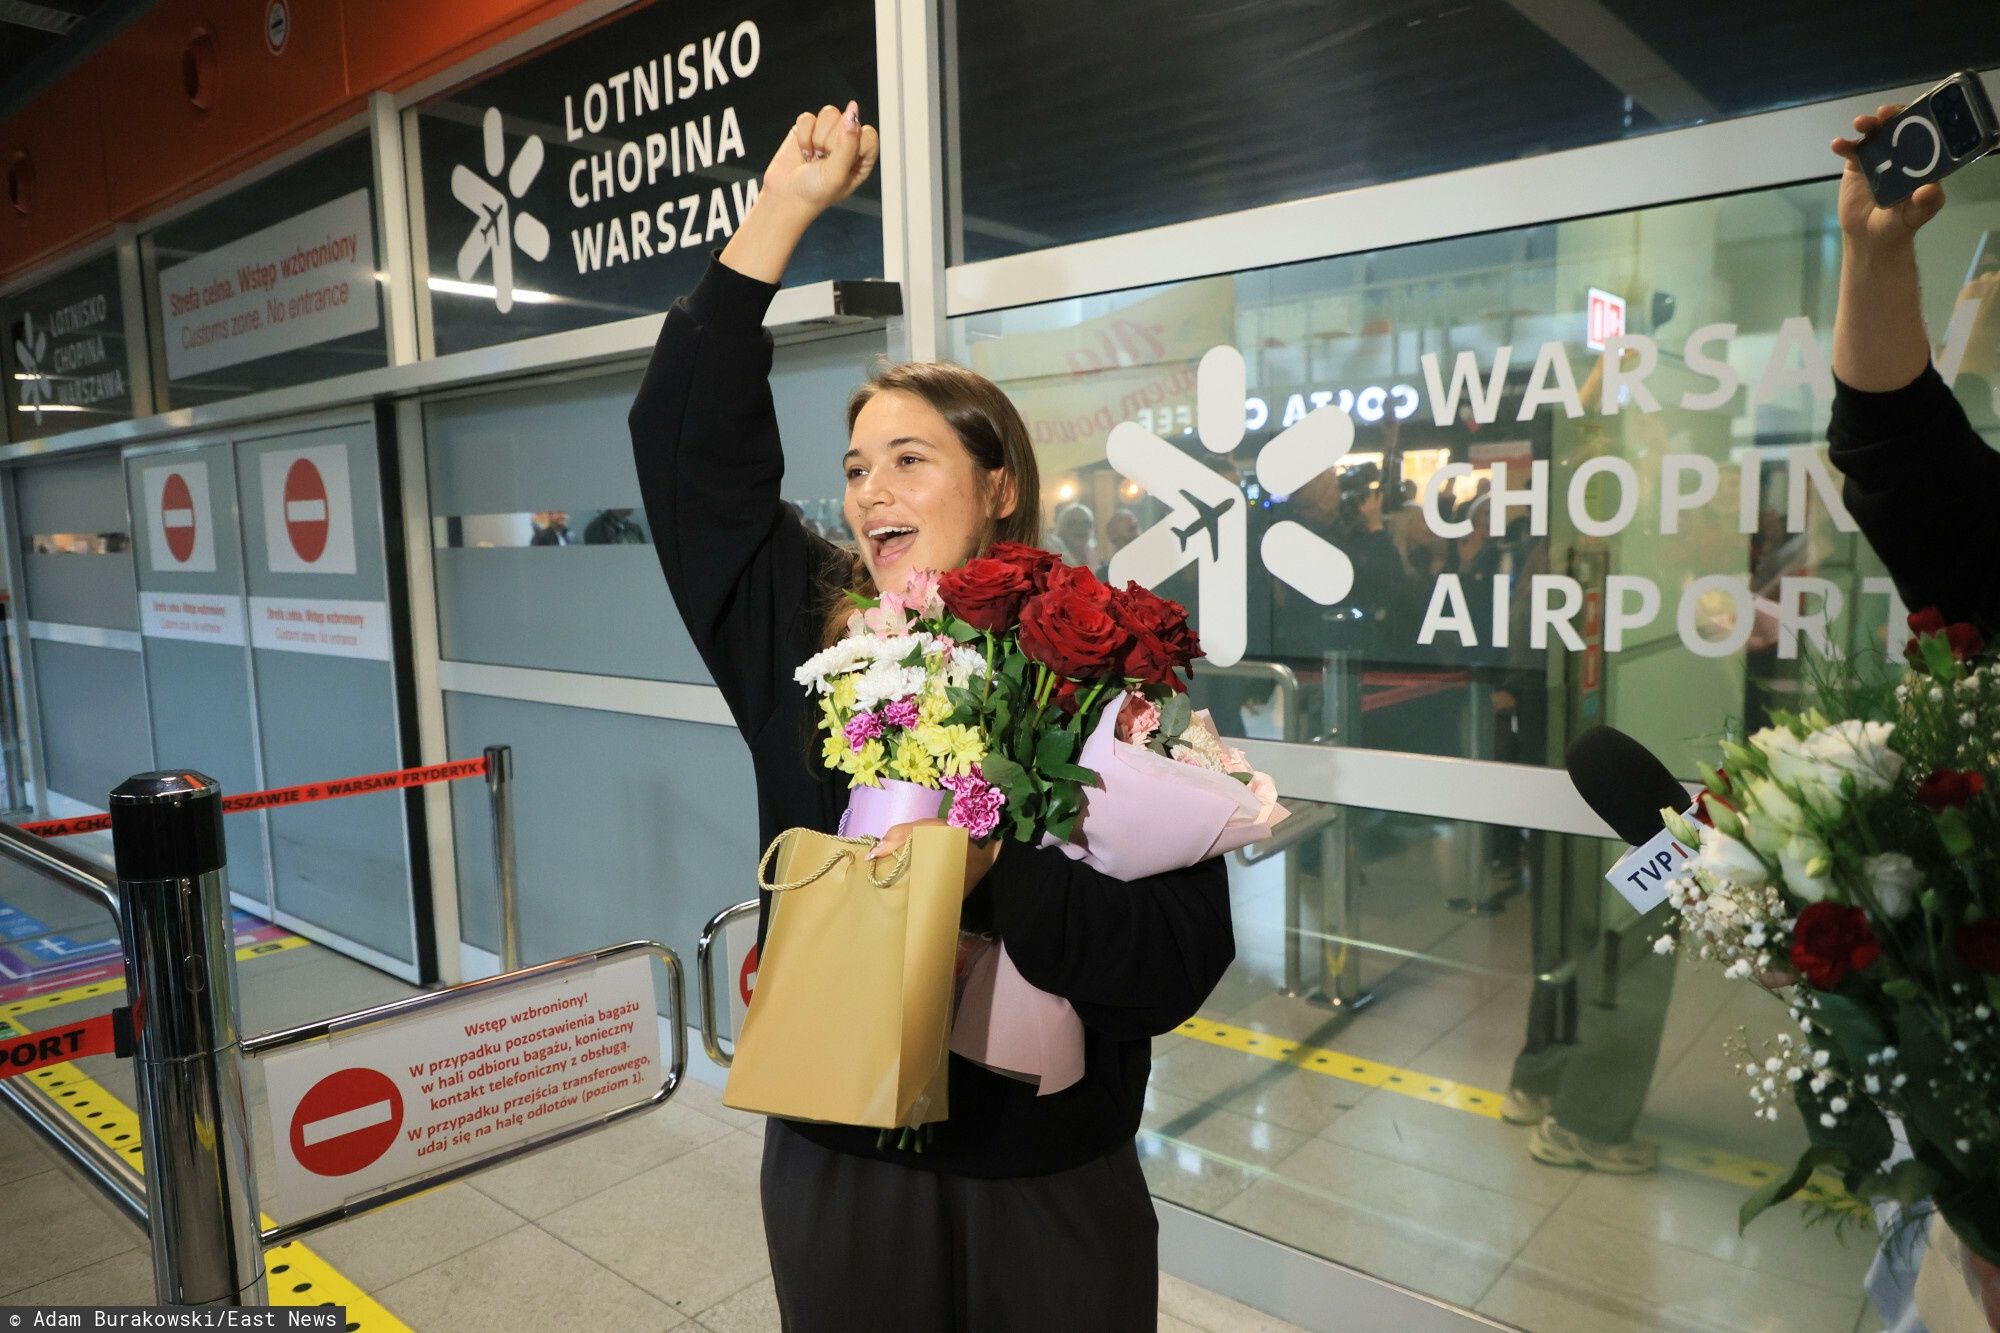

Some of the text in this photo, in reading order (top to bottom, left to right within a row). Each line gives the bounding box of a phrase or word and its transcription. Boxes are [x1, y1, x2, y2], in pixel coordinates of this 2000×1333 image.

[564, 20, 761, 142] LOTNISKO
[568, 106, 746, 208] CHOPINA
[281, 233, 358, 279] wzbroniony
[570, 177, 762, 275] WARSZAW
[266, 296, 286, 325] No
[288, 281, 350, 319] entrance
[223, 790, 299, 810] RSZAWIE
[326, 775, 398, 795] WARSAW
[402, 762, 478, 785] FRYDERYK
[409, 1001, 640, 1078] W przypadku pozostawienia bagażu
[464, 992, 588, 1037] Wstęp wzbroniony!
[421, 1021, 634, 1094] w hali odbioru bagażu, konieczny
[430, 1041, 631, 1111] kontakt telefoniczny z obsługą.
[407, 1055, 651, 1141] W przypadku przejścia transferowego,
[417, 1071, 645, 1157] udaj się na halę odlotów (poziom 1).
